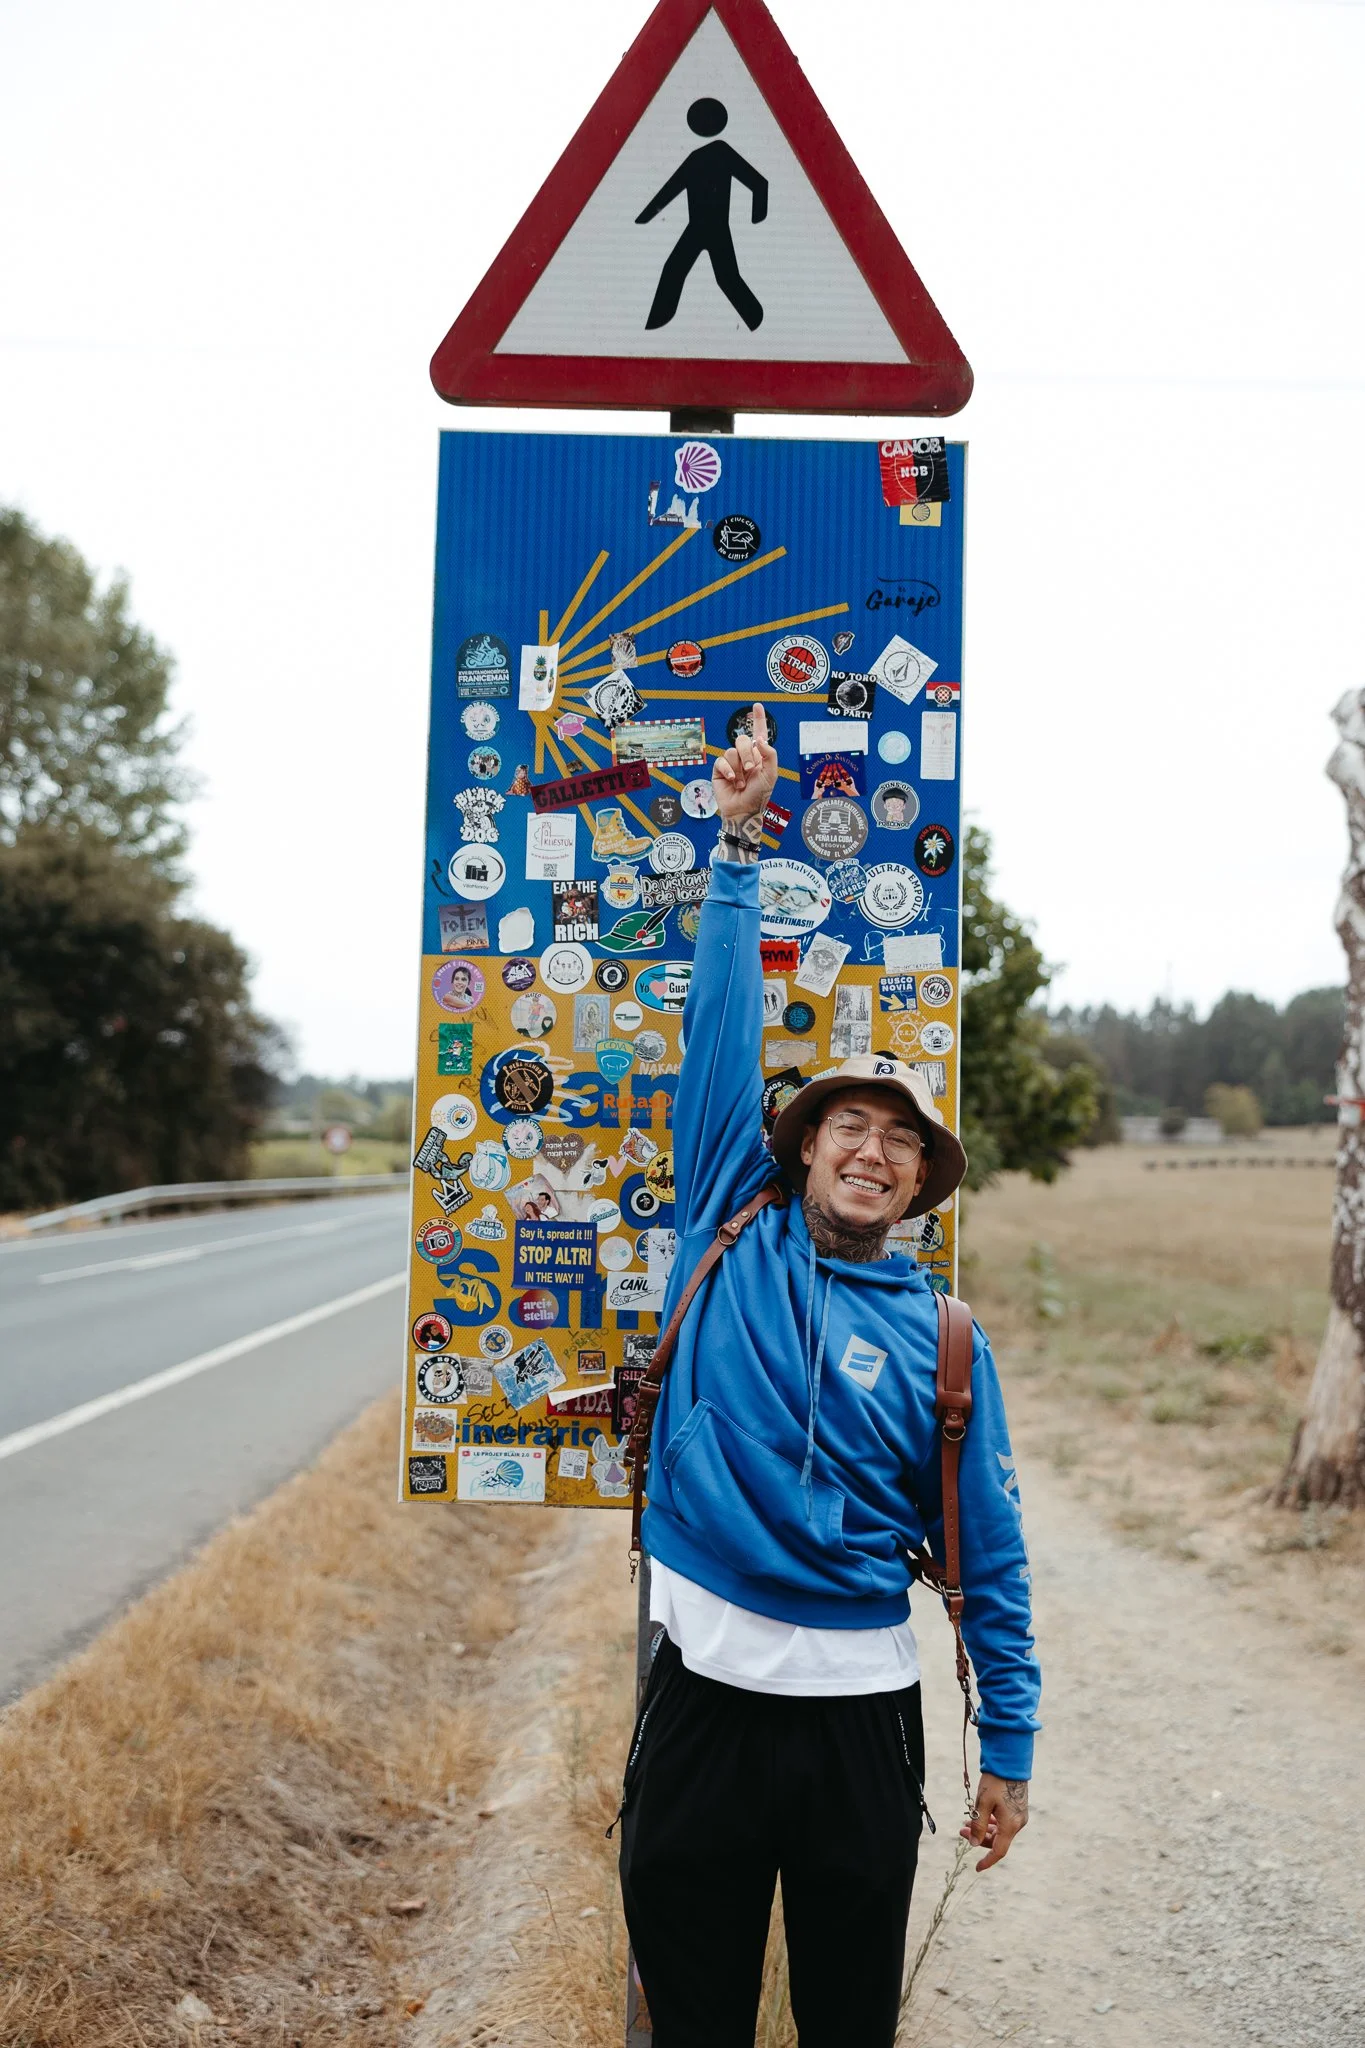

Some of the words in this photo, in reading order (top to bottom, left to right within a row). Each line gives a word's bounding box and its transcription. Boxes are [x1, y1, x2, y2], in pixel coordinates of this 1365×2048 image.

[901, 466, 928, 477] NOB
[728, 551, 749, 560] LIMITS
[866, 589, 940, 617] Garaje
[802, 639, 826, 668] BARCO
[774, 649, 821, 681] ULTRASIL
[458, 674, 509, 682] FRANICEMAN
[770, 661, 818, 692] SIAREIROS
[831, 670, 846, 680] NO
[848, 672, 878, 683] TORO
[828, 707, 840, 716] NO
[843, 708, 873, 720] PARTY
[454, 787, 506, 811] BLACK
[534, 775, 626, 808] GALLETTI
[460, 827, 499, 843] DOG
[815, 834, 830, 842] PEÑA
[830, 834, 837, 842] LA
[838, 835, 853, 843] CUBA
[785, 862, 822, 889] Malvinas
[553, 882, 574, 895] EAT
[576, 881, 597, 893] THE
[643, 876, 658, 892] De
[835, 880, 866, 898] LINARES
[869, 863, 907, 878] ULTRAS
[908, 874, 923, 914] EMPOLI
[656, 889, 673, 902] de
[676, 886, 709, 900] local
[760, 914, 814, 928] ARGENTINAS!!!
[555, 924, 599, 942] RICH
[640, 982, 649, 993] Yo
[881, 977, 913, 985] BUSCO
[882, 984, 913, 992] NOVIA
[438, 1219, 454, 1229] TWO
[919, 1211, 942, 1247] 194
[520, 1227, 533, 1240] Say
[535, 1228, 545, 1240] it,
[547, 1229, 575, 1241] spread
[576, 1229, 583, 1239] it
[584, 1229, 592, 1240] !!!
[519, 1246, 552, 1265] STOP
[555, 1247, 592, 1266] ALTRI
[525, 1271, 534, 1282] IN
[536, 1272, 553, 1283] THE
[554, 1272, 574, 1284] WAY
[575, 1273, 584, 1284] !!!
[524, 1310, 554, 1321] stella
[419, 1360, 433, 1375] DIE
[421, 1389, 462, 1404] LATSCHOS
